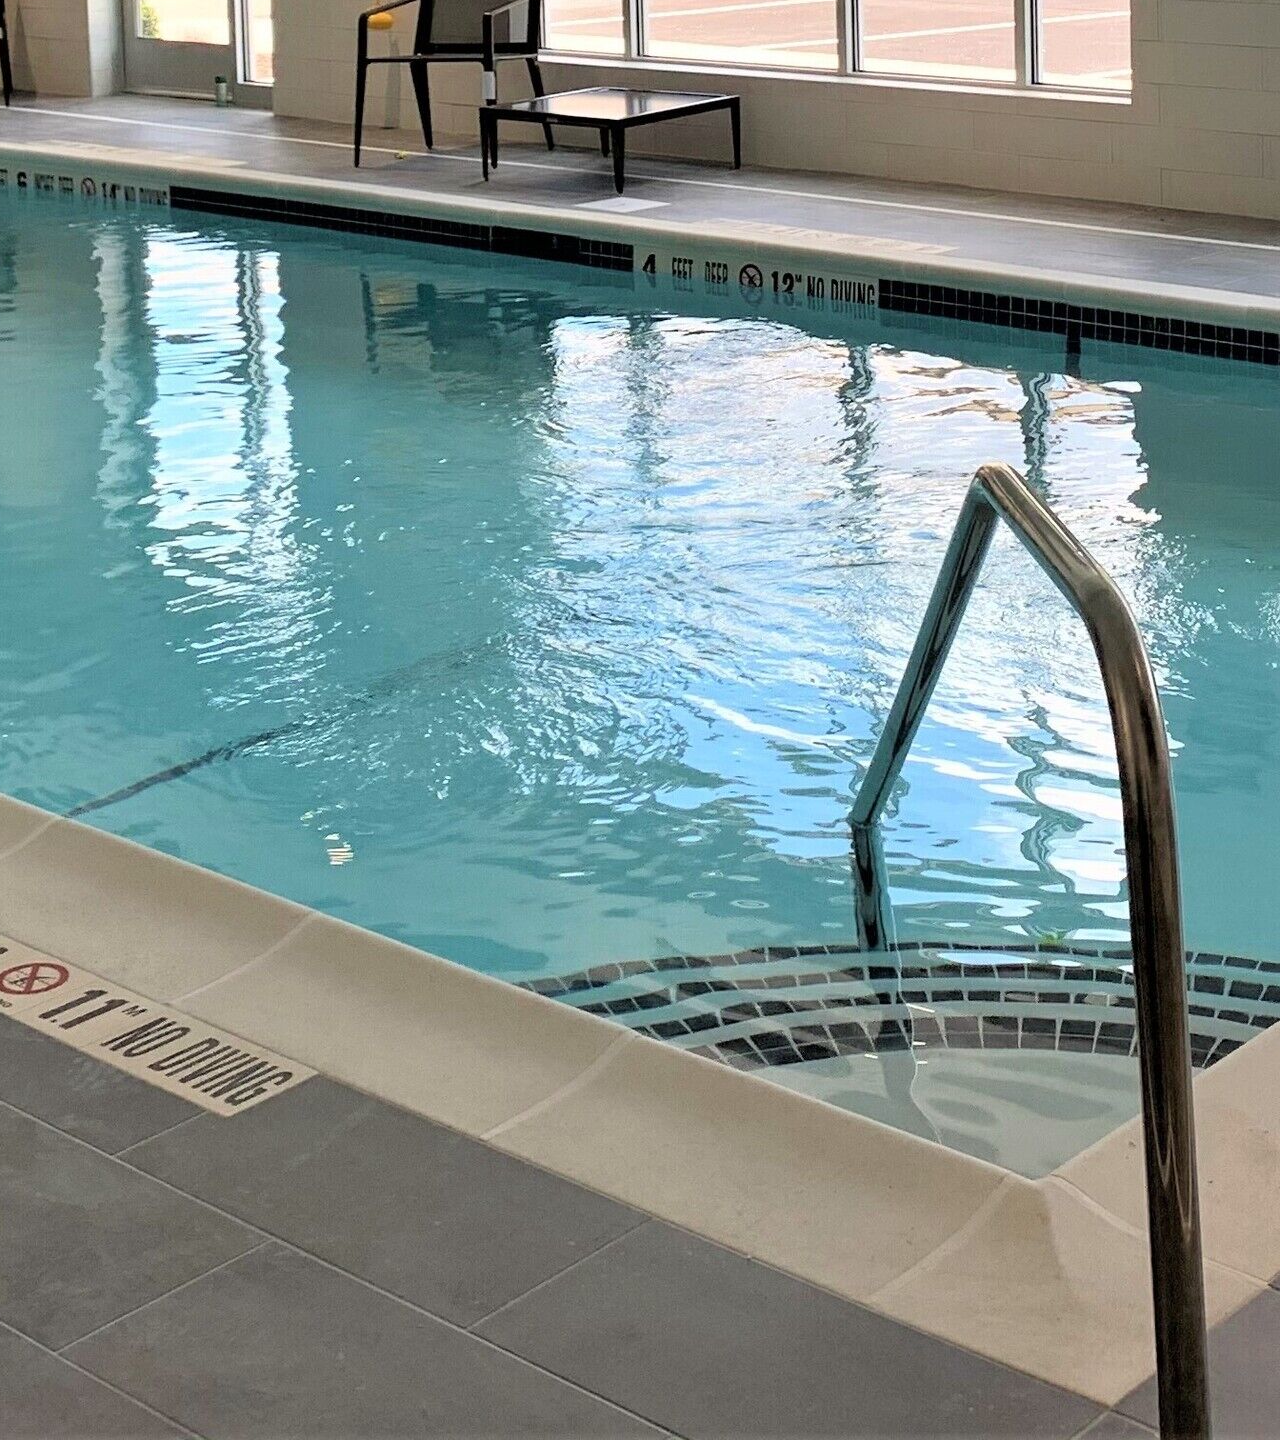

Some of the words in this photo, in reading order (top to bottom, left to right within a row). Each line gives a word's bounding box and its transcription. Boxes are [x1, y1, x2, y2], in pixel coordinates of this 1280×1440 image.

[642, 253, 657, 274] 4
[672, 257, 693, 279] FEET
[807, 276, 824, 299] NO
[831, 278, 875, 306] DIVING
[100, 1017, 191, 1058] NO
[147, 1037, 293, 1106] DIVING
